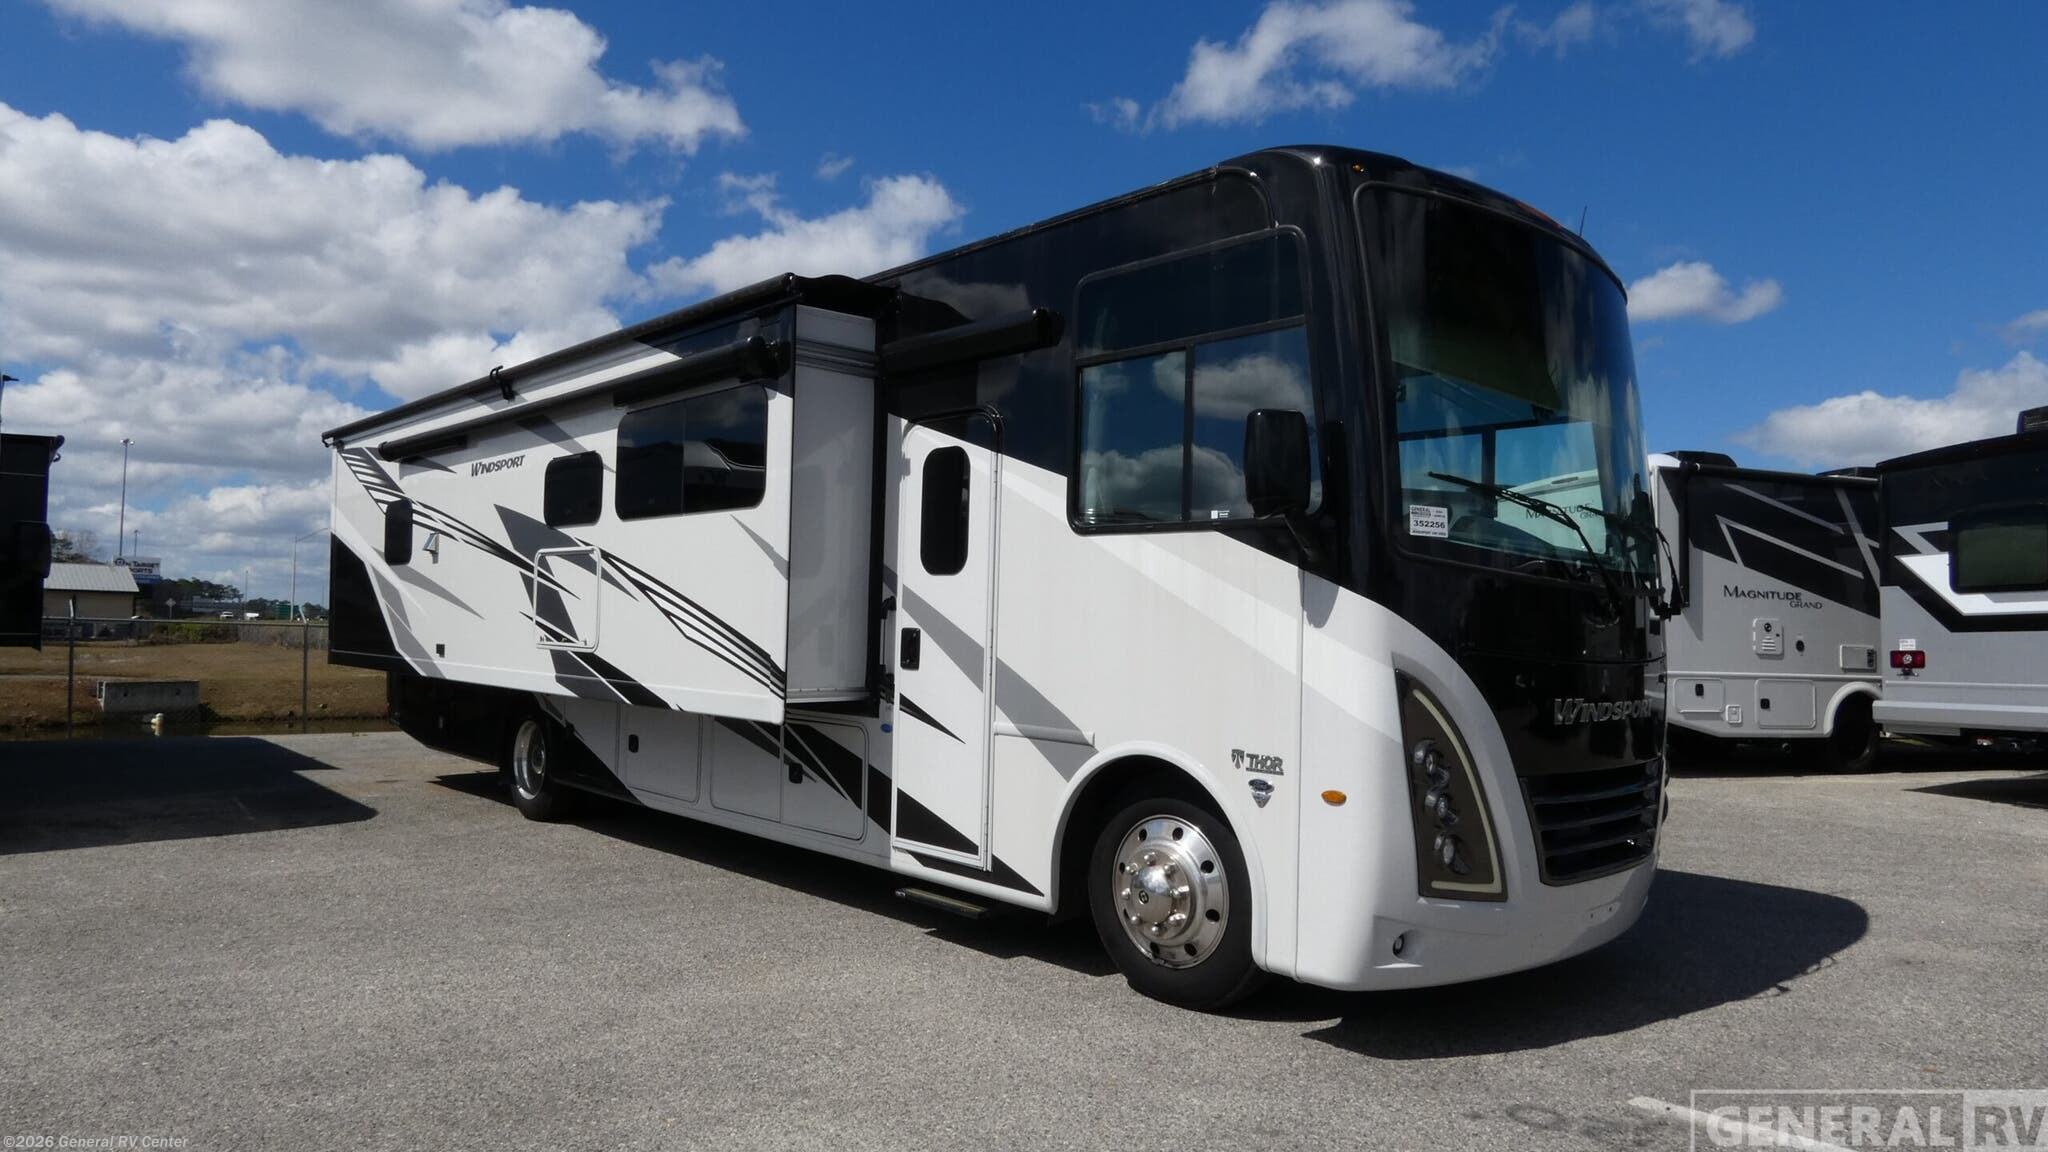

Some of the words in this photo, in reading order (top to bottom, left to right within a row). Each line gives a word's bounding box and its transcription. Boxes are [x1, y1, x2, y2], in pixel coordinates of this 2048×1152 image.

[471, 454, 526, 477] WINDSPORT
[1413, 520, 1446, 529] 352256
[1723, 584, 1802, 601] MAGNITUDE
[1789, 600, 1823, 610] GRAND
[1553, 698, 1653, 725] WINDSPORT
[1245, 752, 1284, 772] THOR
